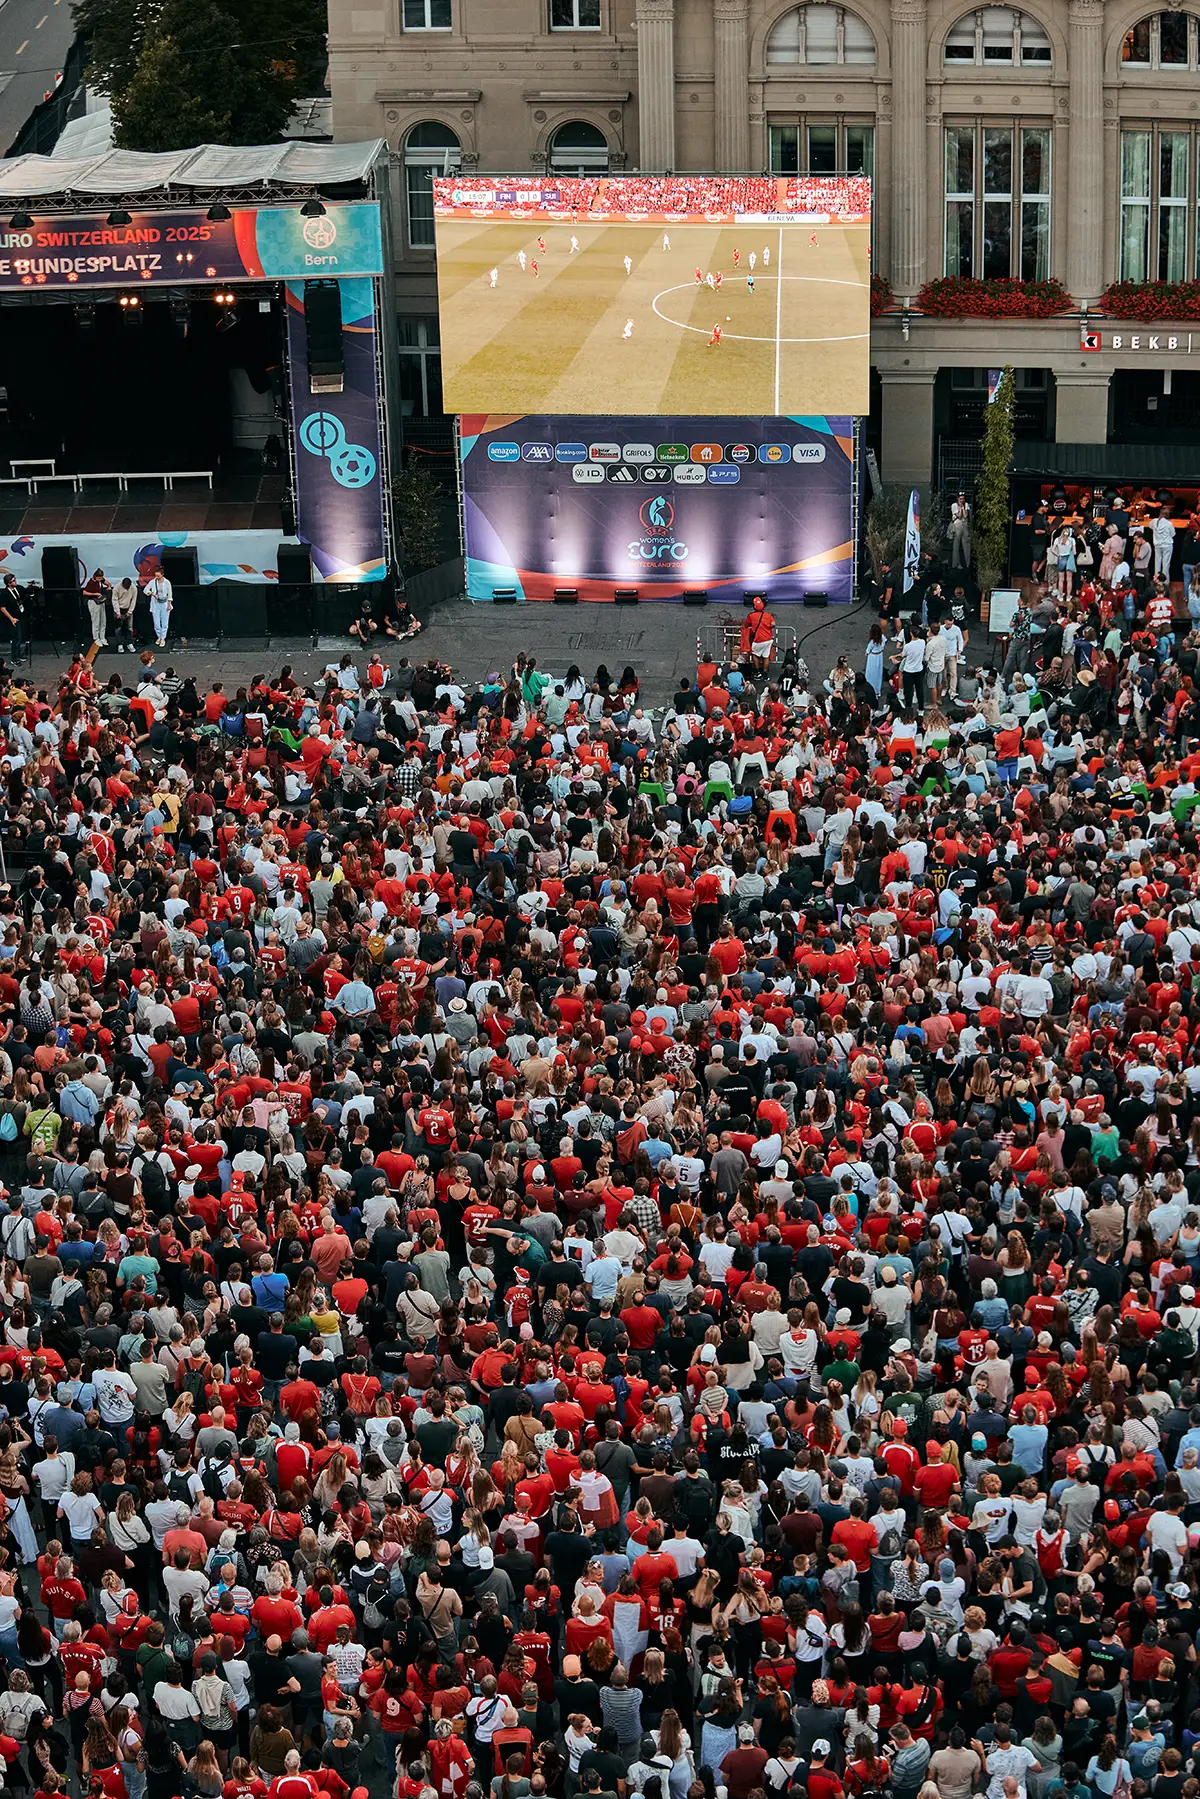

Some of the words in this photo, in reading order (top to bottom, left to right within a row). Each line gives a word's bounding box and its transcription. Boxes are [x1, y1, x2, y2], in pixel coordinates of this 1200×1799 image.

[36, 228, 161, 248] SWITZERLAND
[165, 226, 212, 242] 2025
[16, 254, 162, 275] BUNDESPLATZ
[305, 254, 338, 266] Bern
[1112, 336, 1178, 350] BEKB
[490, 448, 518, 457] amazon
[525, 446, 550, 458] AXA
[799, 449, 820, 457] VISA
[640, 536, 675, 544] women's
[934, 874, 945, 888] 10
[233, 896, 241, 910] 9
[211, 907, 218, 921] 7
[679, 1168, 687, 1182] 5
[386, 1697, 400, 1717] 9
